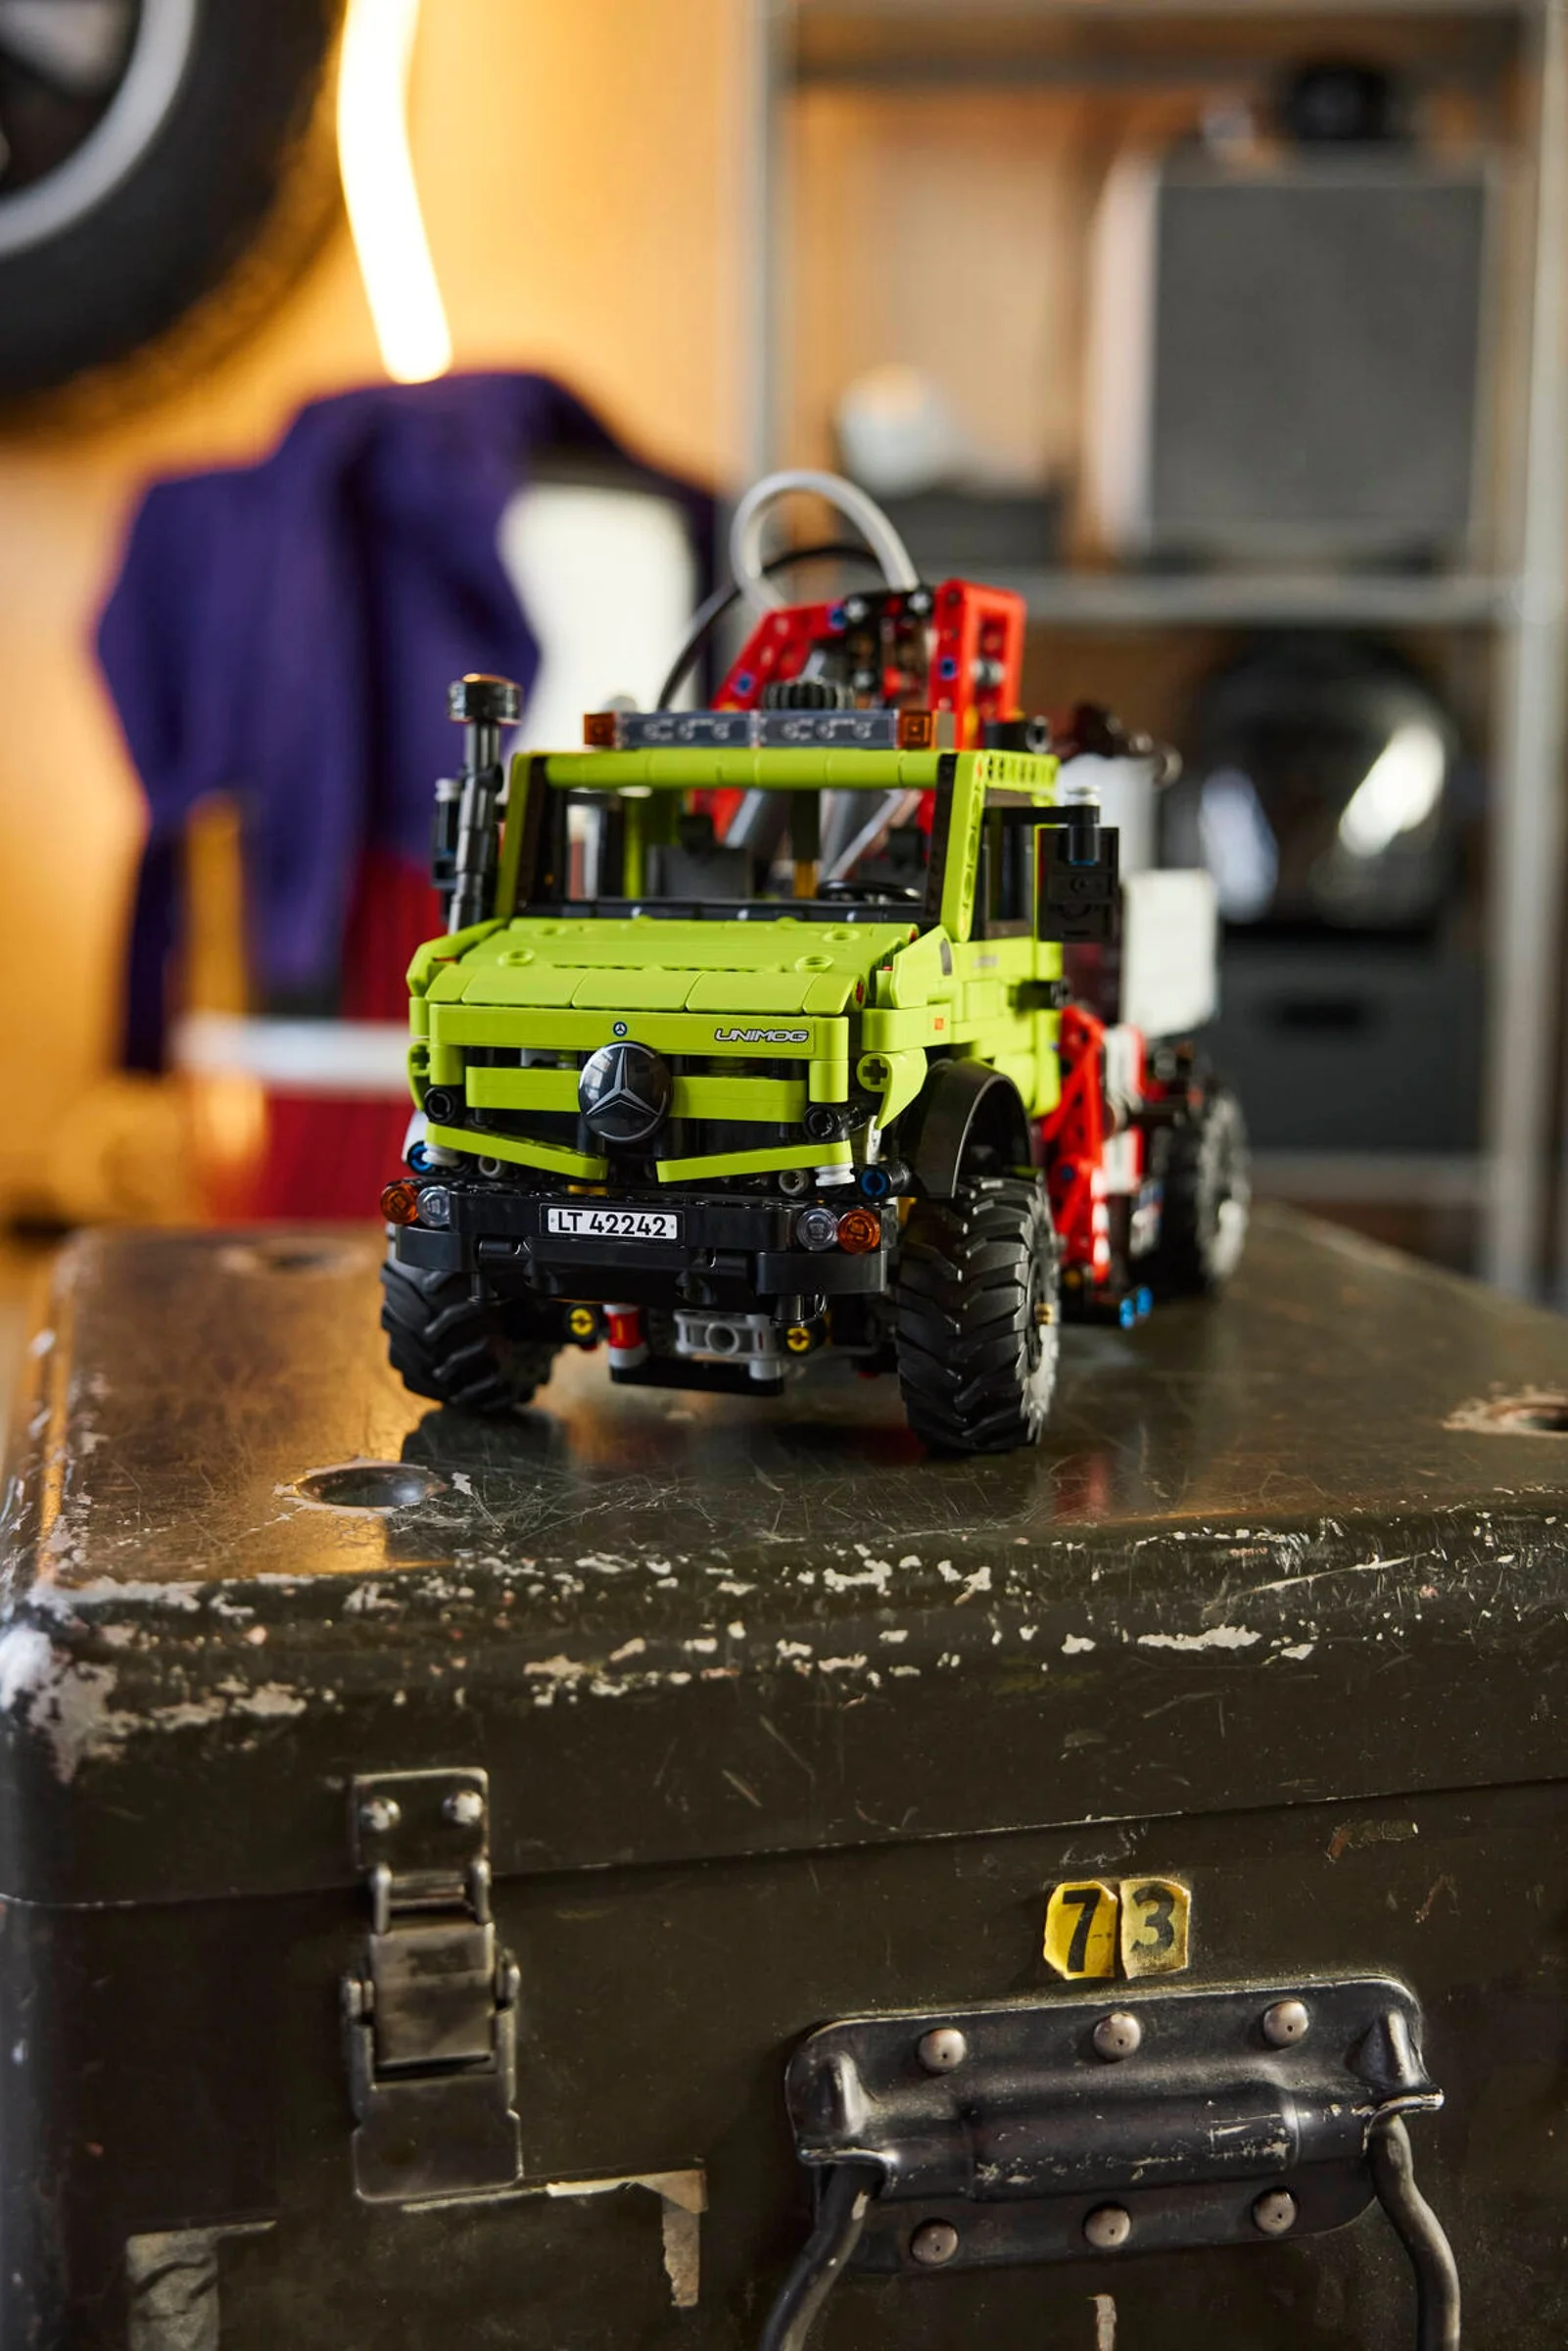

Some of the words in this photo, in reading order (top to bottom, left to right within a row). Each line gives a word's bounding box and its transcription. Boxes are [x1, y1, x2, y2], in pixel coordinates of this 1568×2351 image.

[715, 1028, 809, 1042] UNIMOG
[558, 1211, 583, 1231] LT
[590, 1213, 667, 1236] 42242
